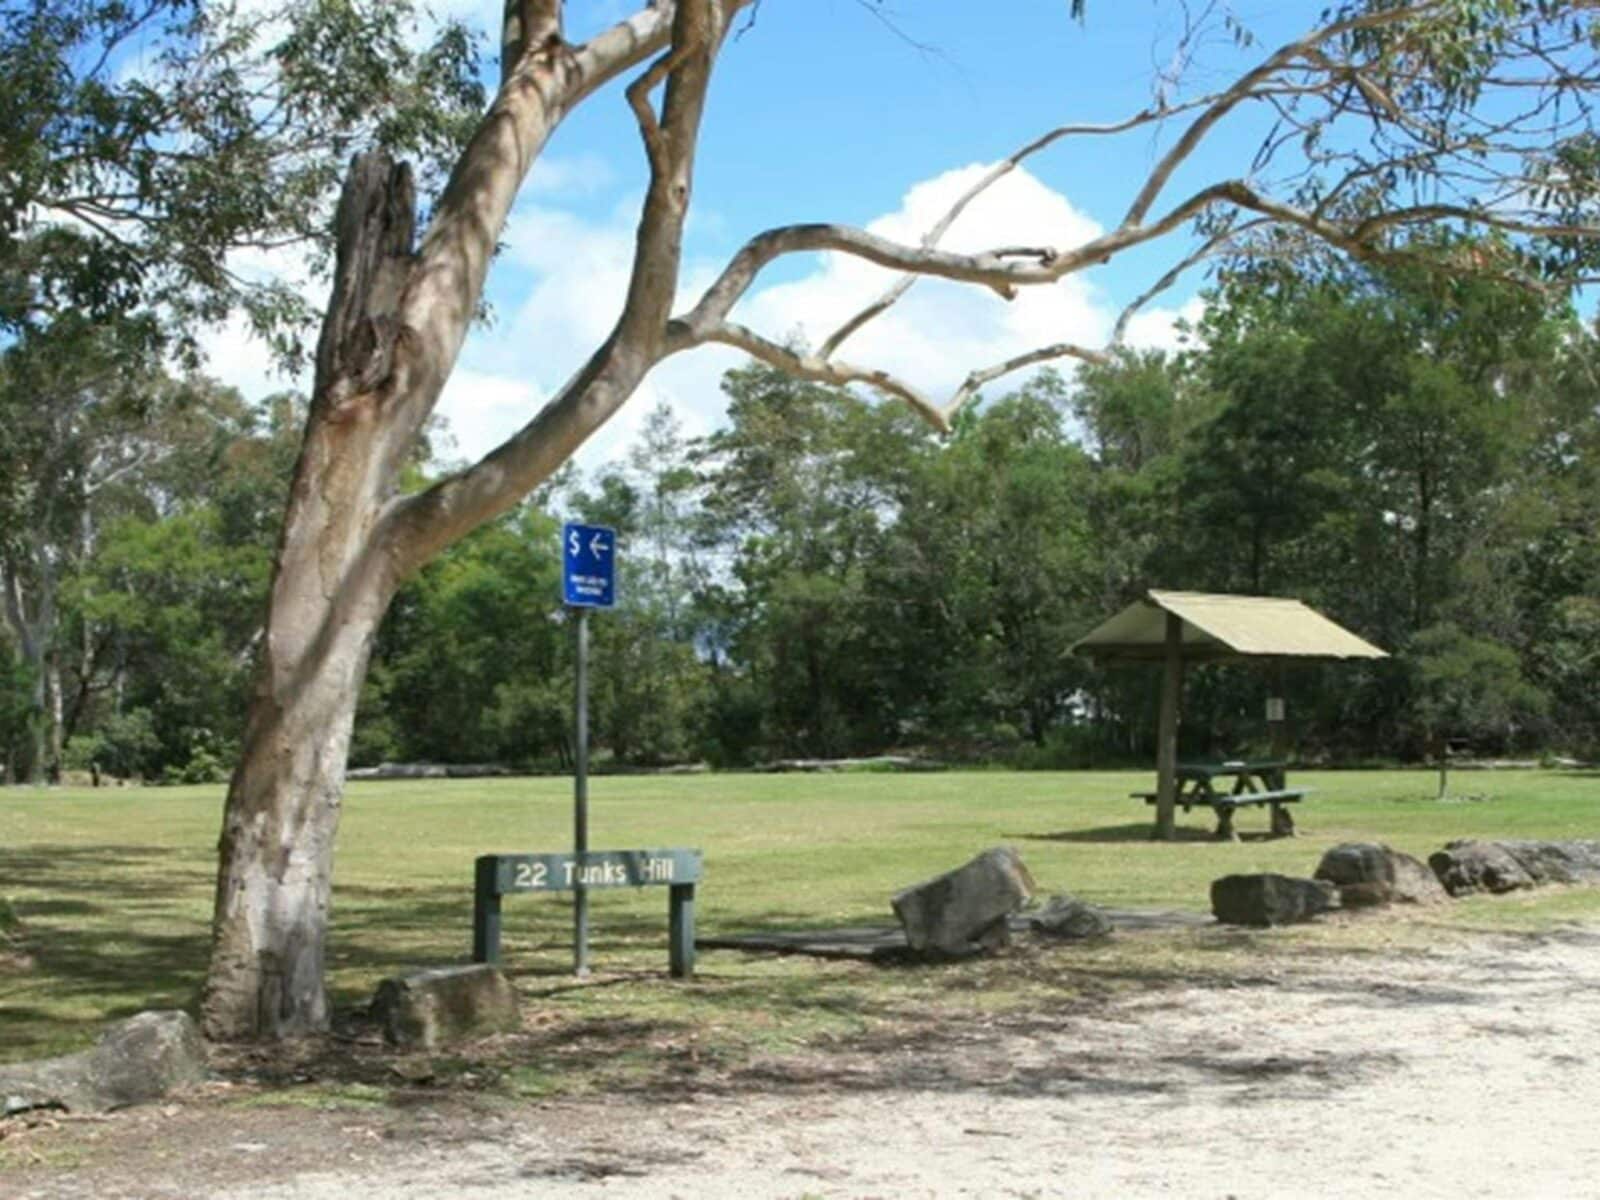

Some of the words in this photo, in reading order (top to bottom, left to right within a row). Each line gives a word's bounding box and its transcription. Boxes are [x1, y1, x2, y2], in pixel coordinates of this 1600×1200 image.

[514, 863, 547, 887] 22
[563, 861, 627, 885] Tunks
[639, 858, 675, 880] Hill
